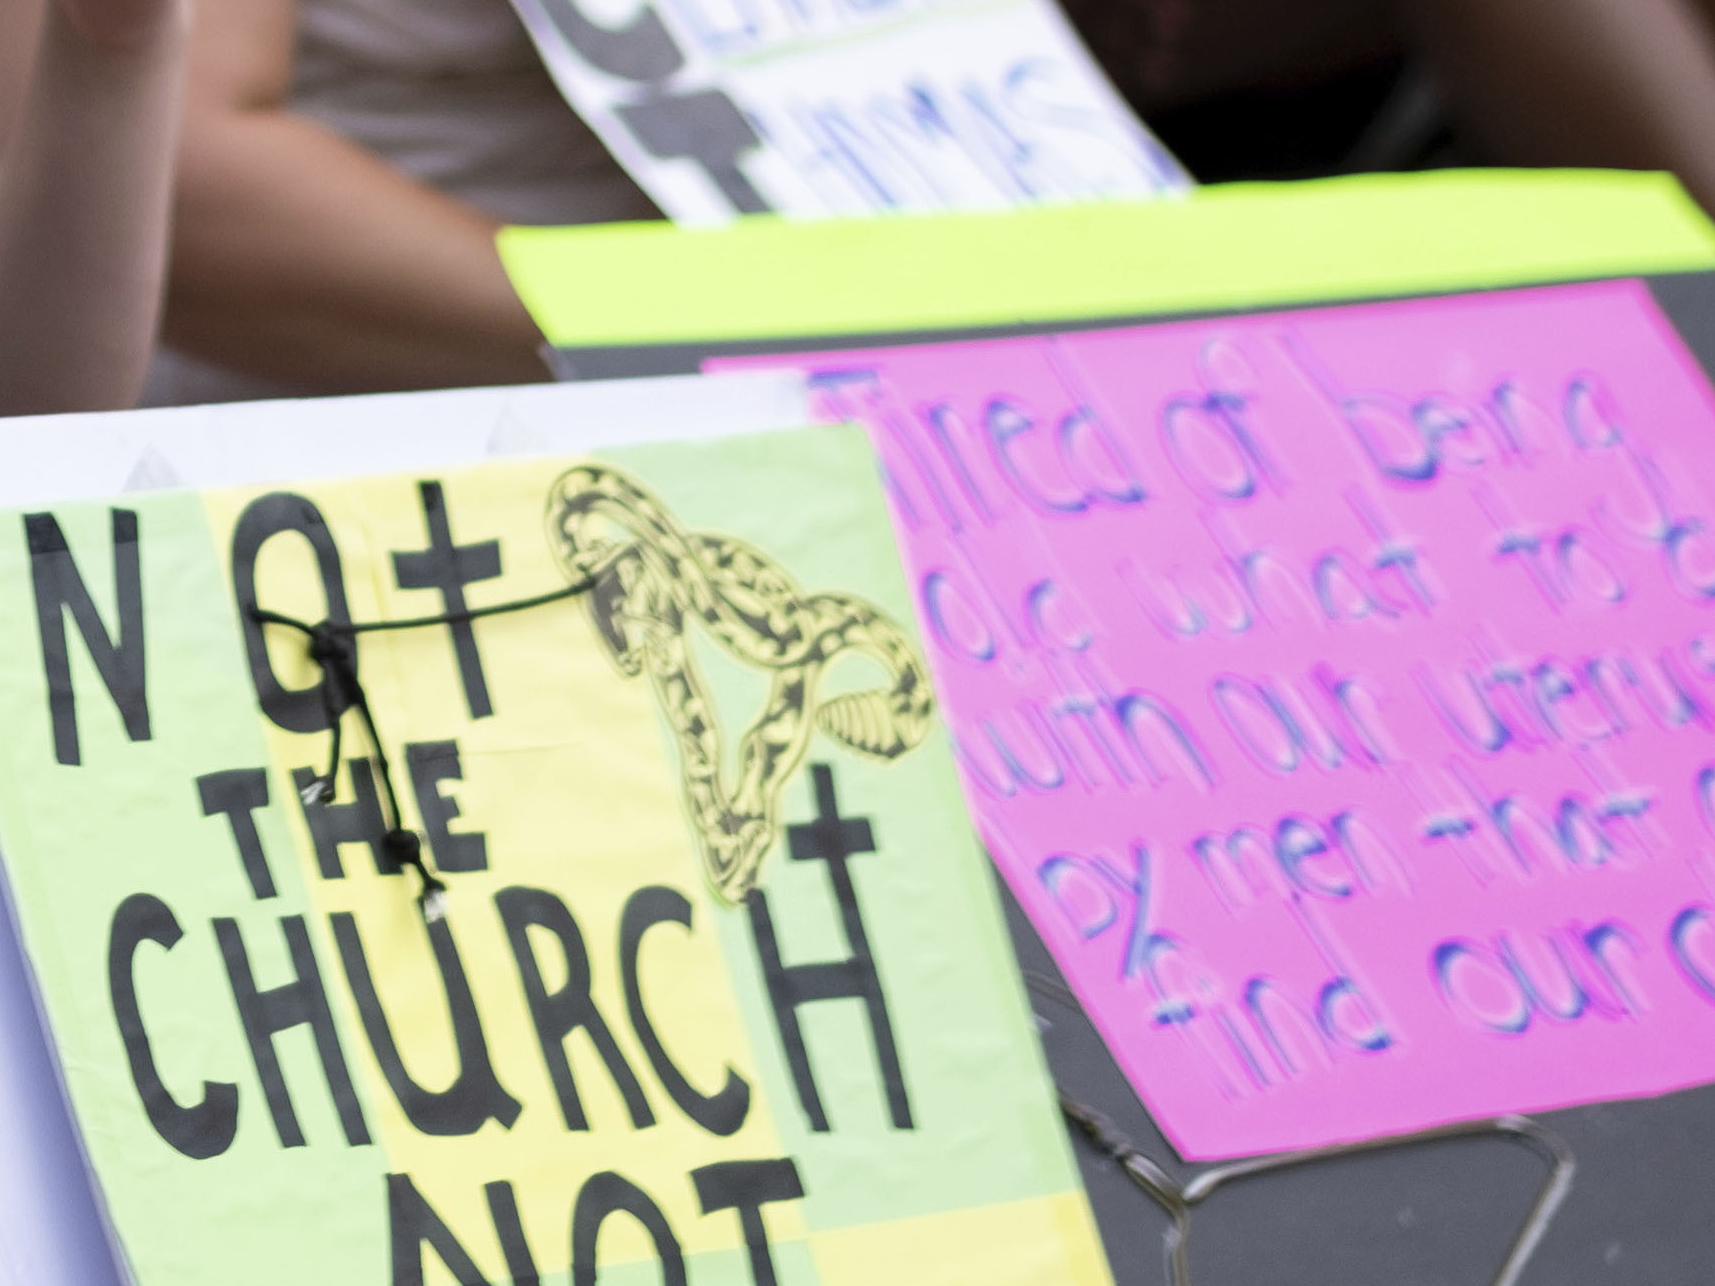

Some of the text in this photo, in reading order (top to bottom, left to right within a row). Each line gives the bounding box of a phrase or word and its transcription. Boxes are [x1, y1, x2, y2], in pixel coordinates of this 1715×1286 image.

[1159, 336, 1284, 505] of
[24, 480, 502, 766] NOT
[1115, 483, 1434, 638] what
[1471, 488, 1625, 613] to
[943, 652, 1219, 797] with
[1211, 668, 1393, 772] our
[195, 740, 489, 900] THE
[1191, 811, 1414, 917] men
[108, 763, 916, 1161] CHURCH
[1147, 900, 1396, 1102] find
[1431, 923, 1648, 1034] our
